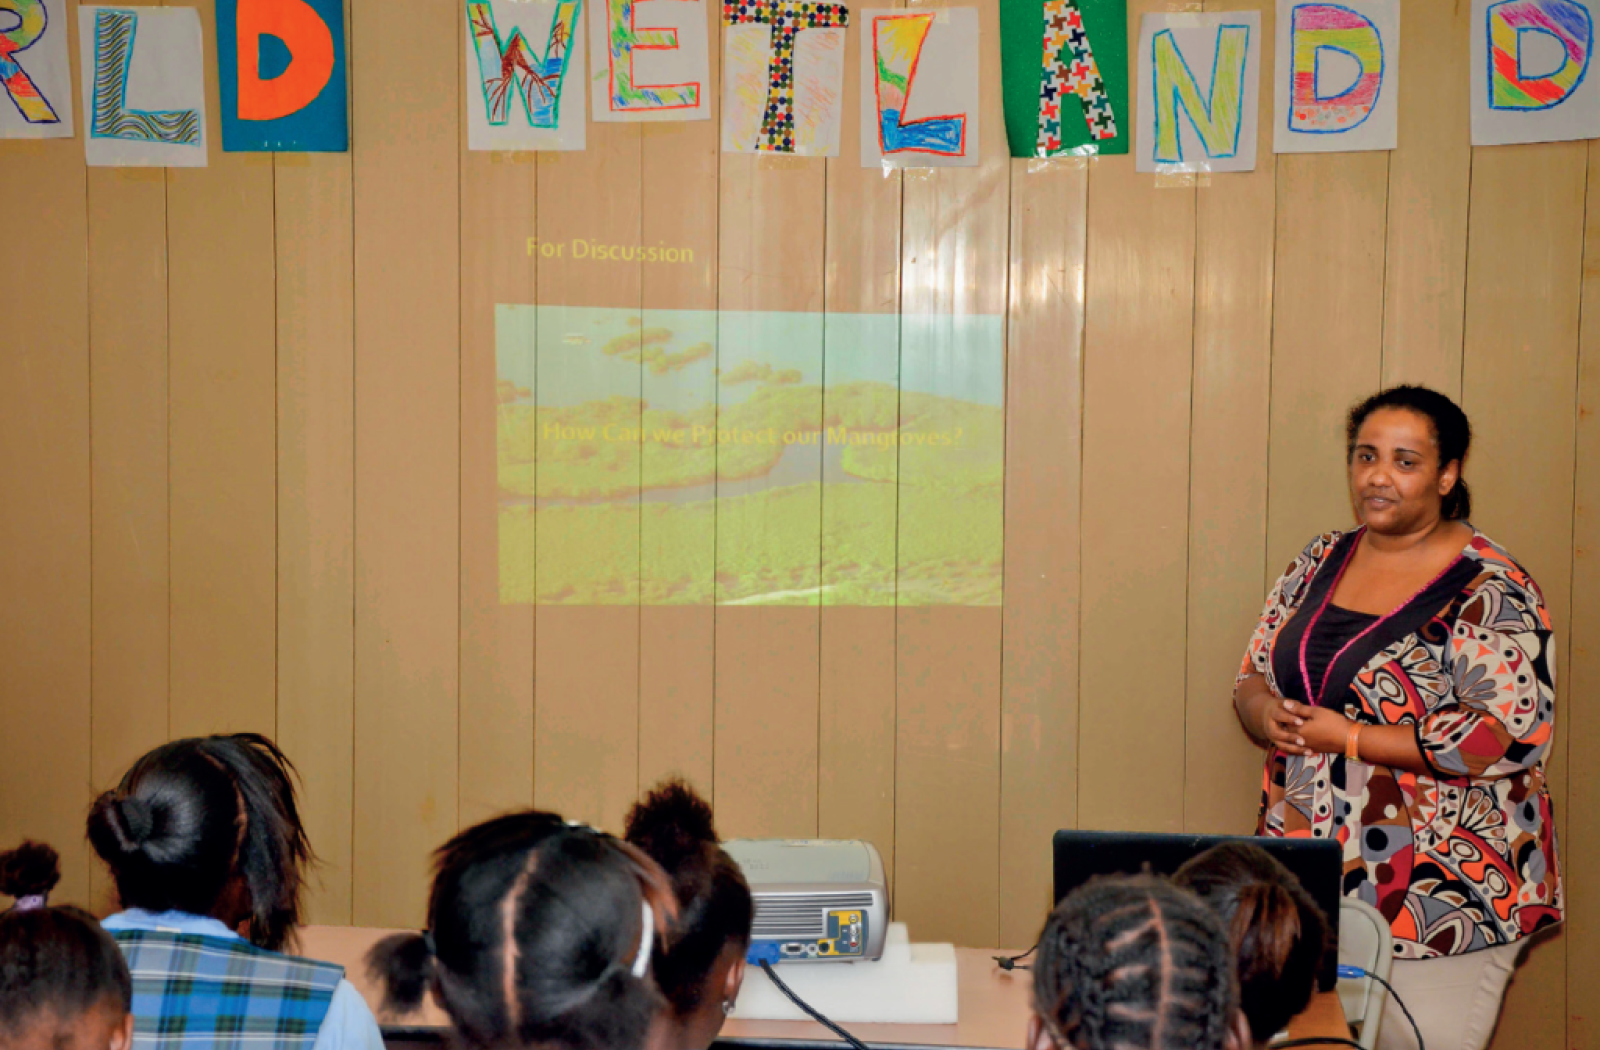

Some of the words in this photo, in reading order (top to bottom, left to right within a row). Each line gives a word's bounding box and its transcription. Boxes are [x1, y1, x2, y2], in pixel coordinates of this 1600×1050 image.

[526, 236, 565, 258] For
[572, 238, 694, 263] Discussion
[543, 421, 596, 440] How
[602, 422, 646, 442] Can
[652, 427, 685, 443] we
[691, 423, 776, 446] Protect
[783, 428, 823, 446] our
[827, 427, 963, 452] Mangroves?
